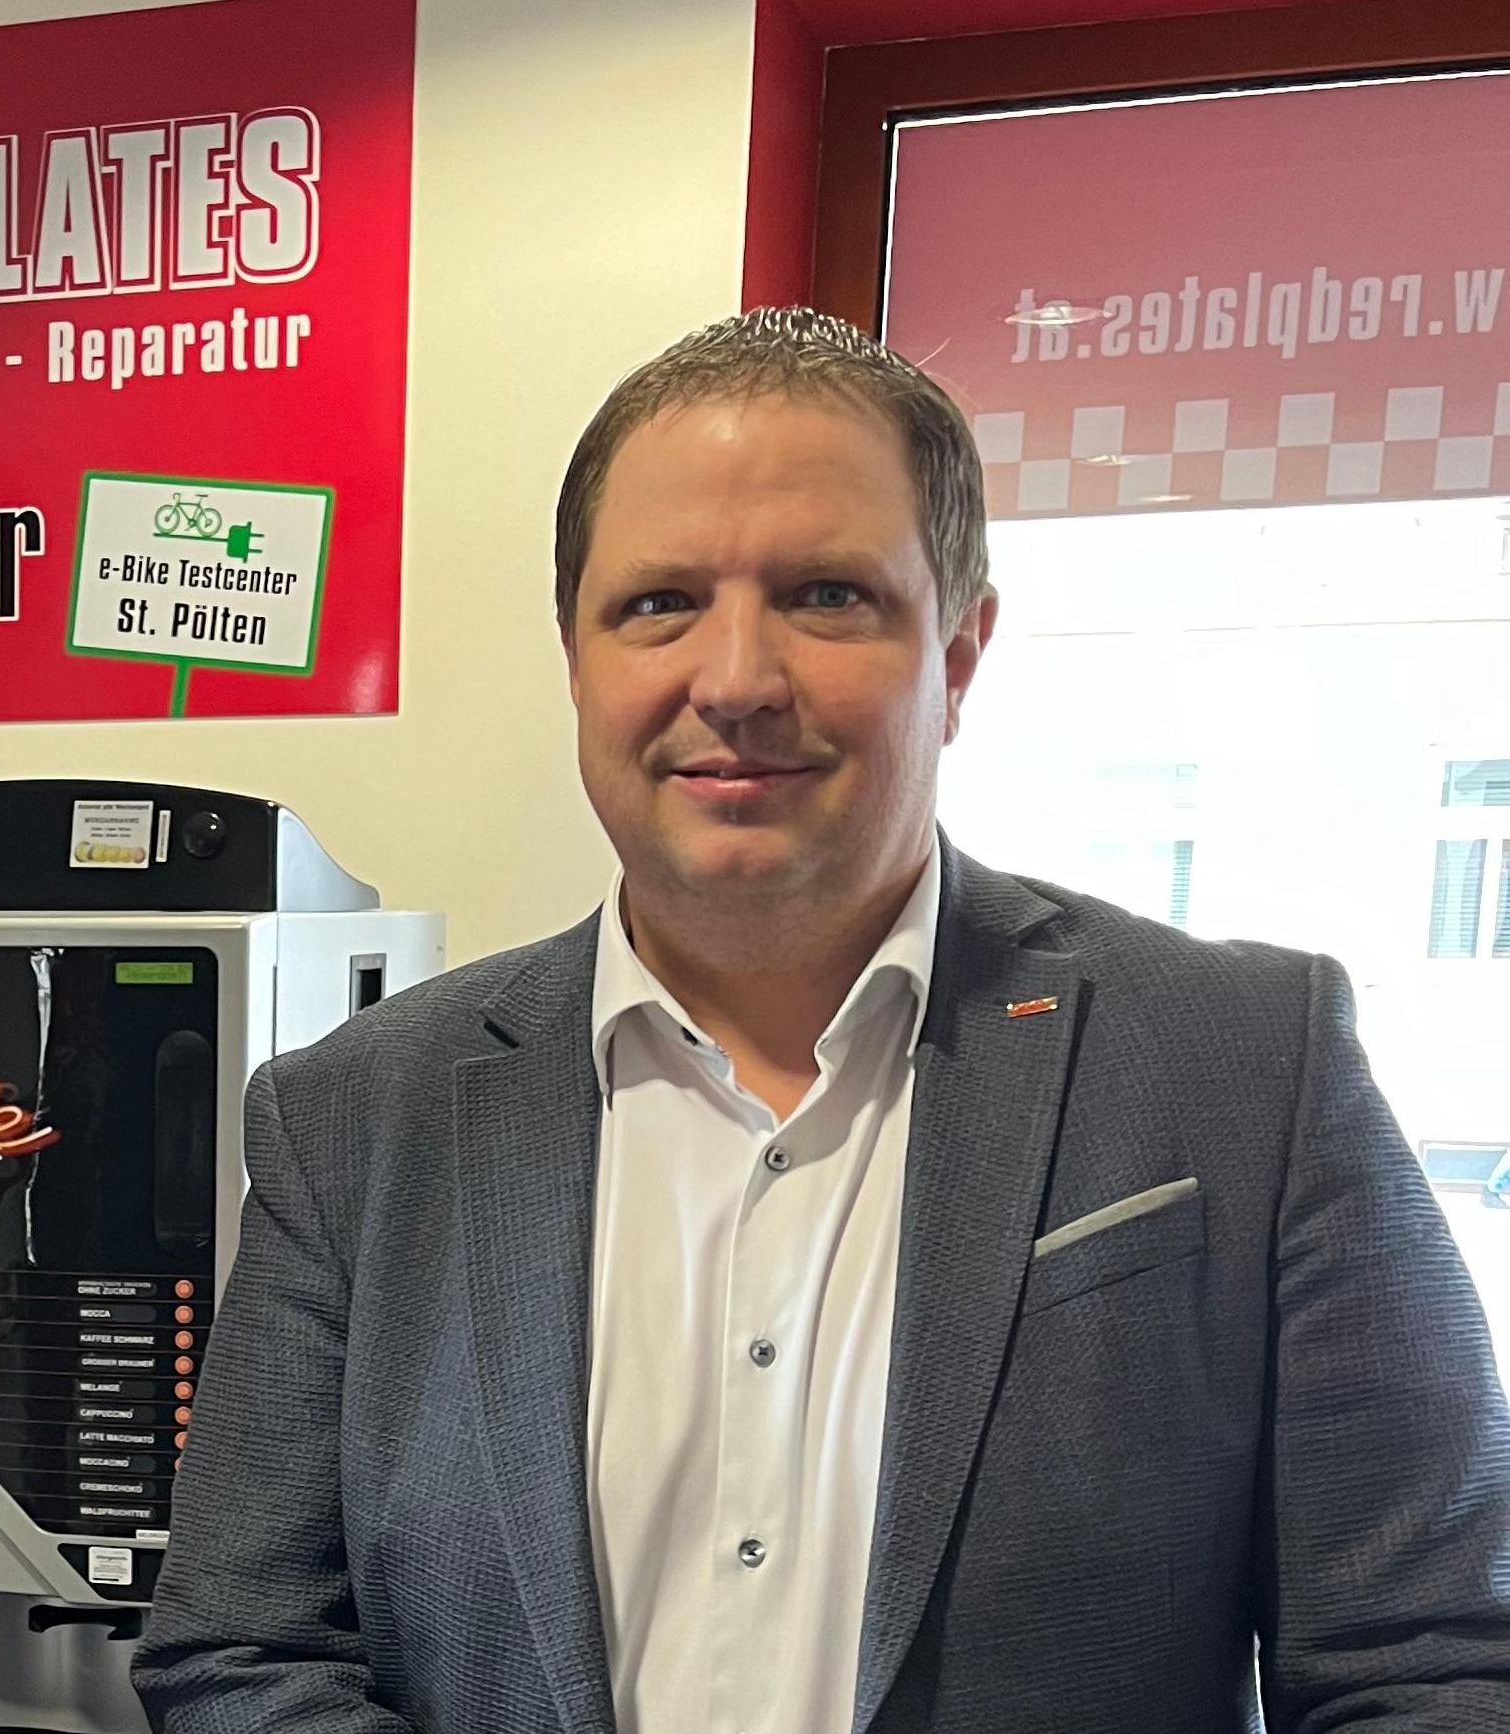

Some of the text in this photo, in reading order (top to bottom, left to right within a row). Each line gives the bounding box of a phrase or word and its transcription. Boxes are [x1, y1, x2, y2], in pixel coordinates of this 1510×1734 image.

[47, 308, 312, 390] Reparatur
[98, 553, 298, 598] e-Bike Testcenter
[116, 597, 268, 646] St. Pölten
